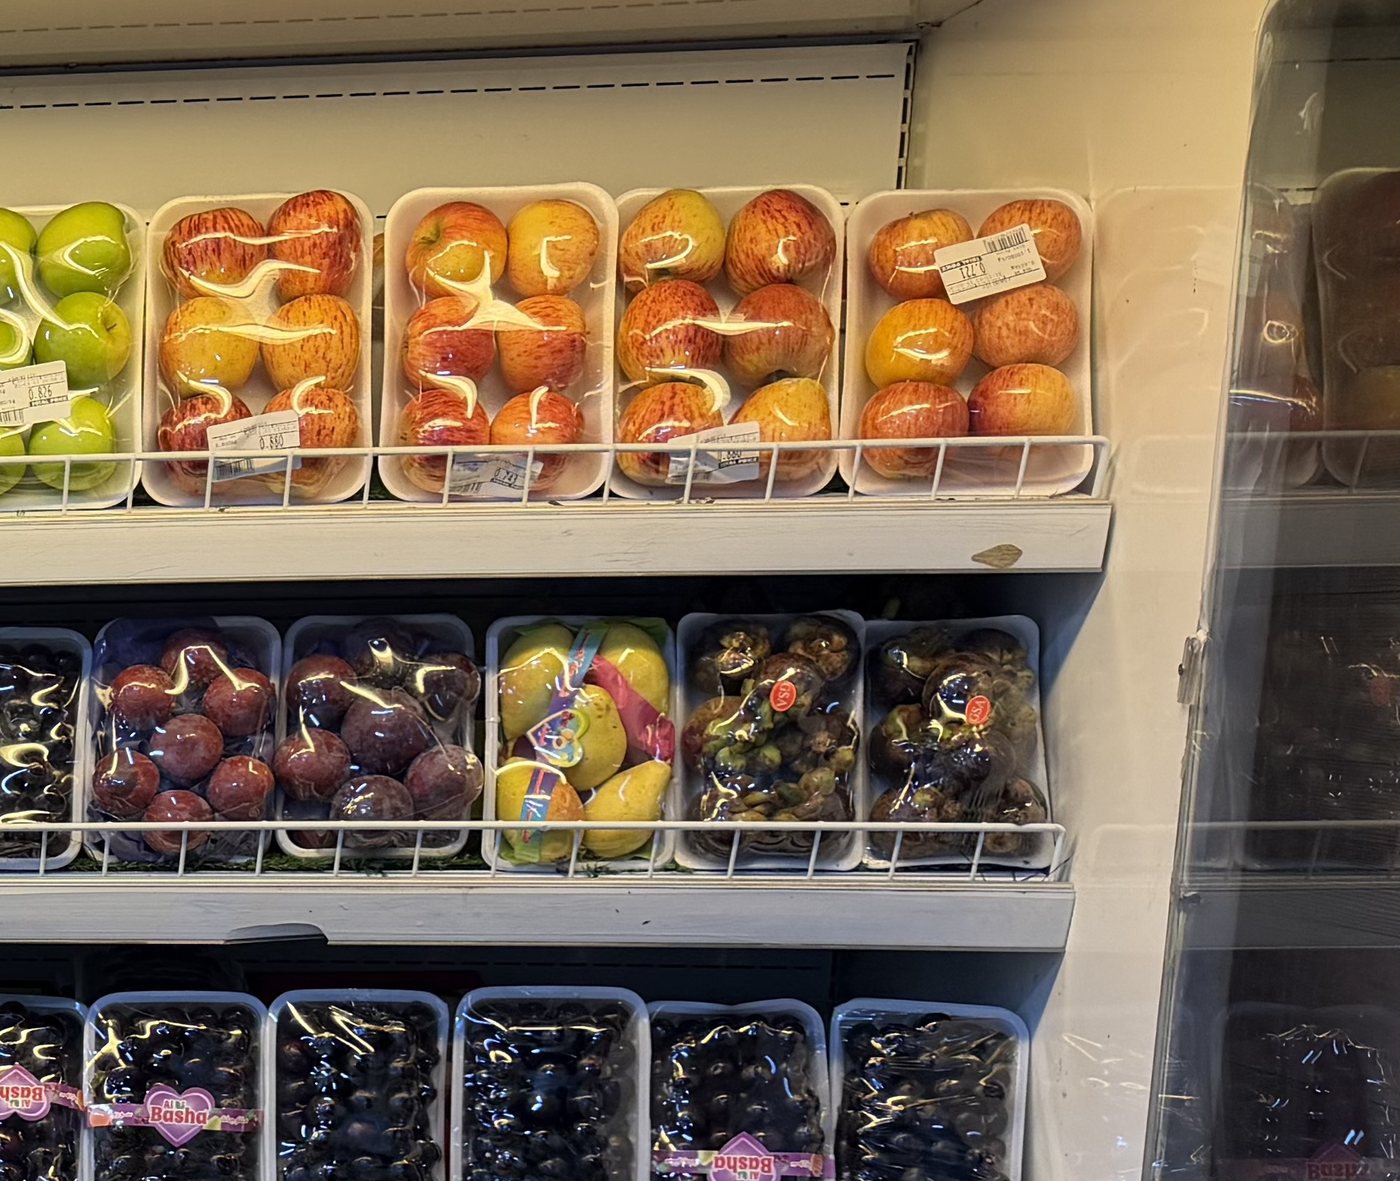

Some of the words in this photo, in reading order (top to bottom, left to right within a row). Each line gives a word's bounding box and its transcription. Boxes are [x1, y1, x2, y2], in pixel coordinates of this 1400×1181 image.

[960, 263, 986, 280] 0.721
[28, 386, 54, 400] 0.826
[150, 1105, 208, 1125] Basha
[713, 1154, 773, 1174] Basha
